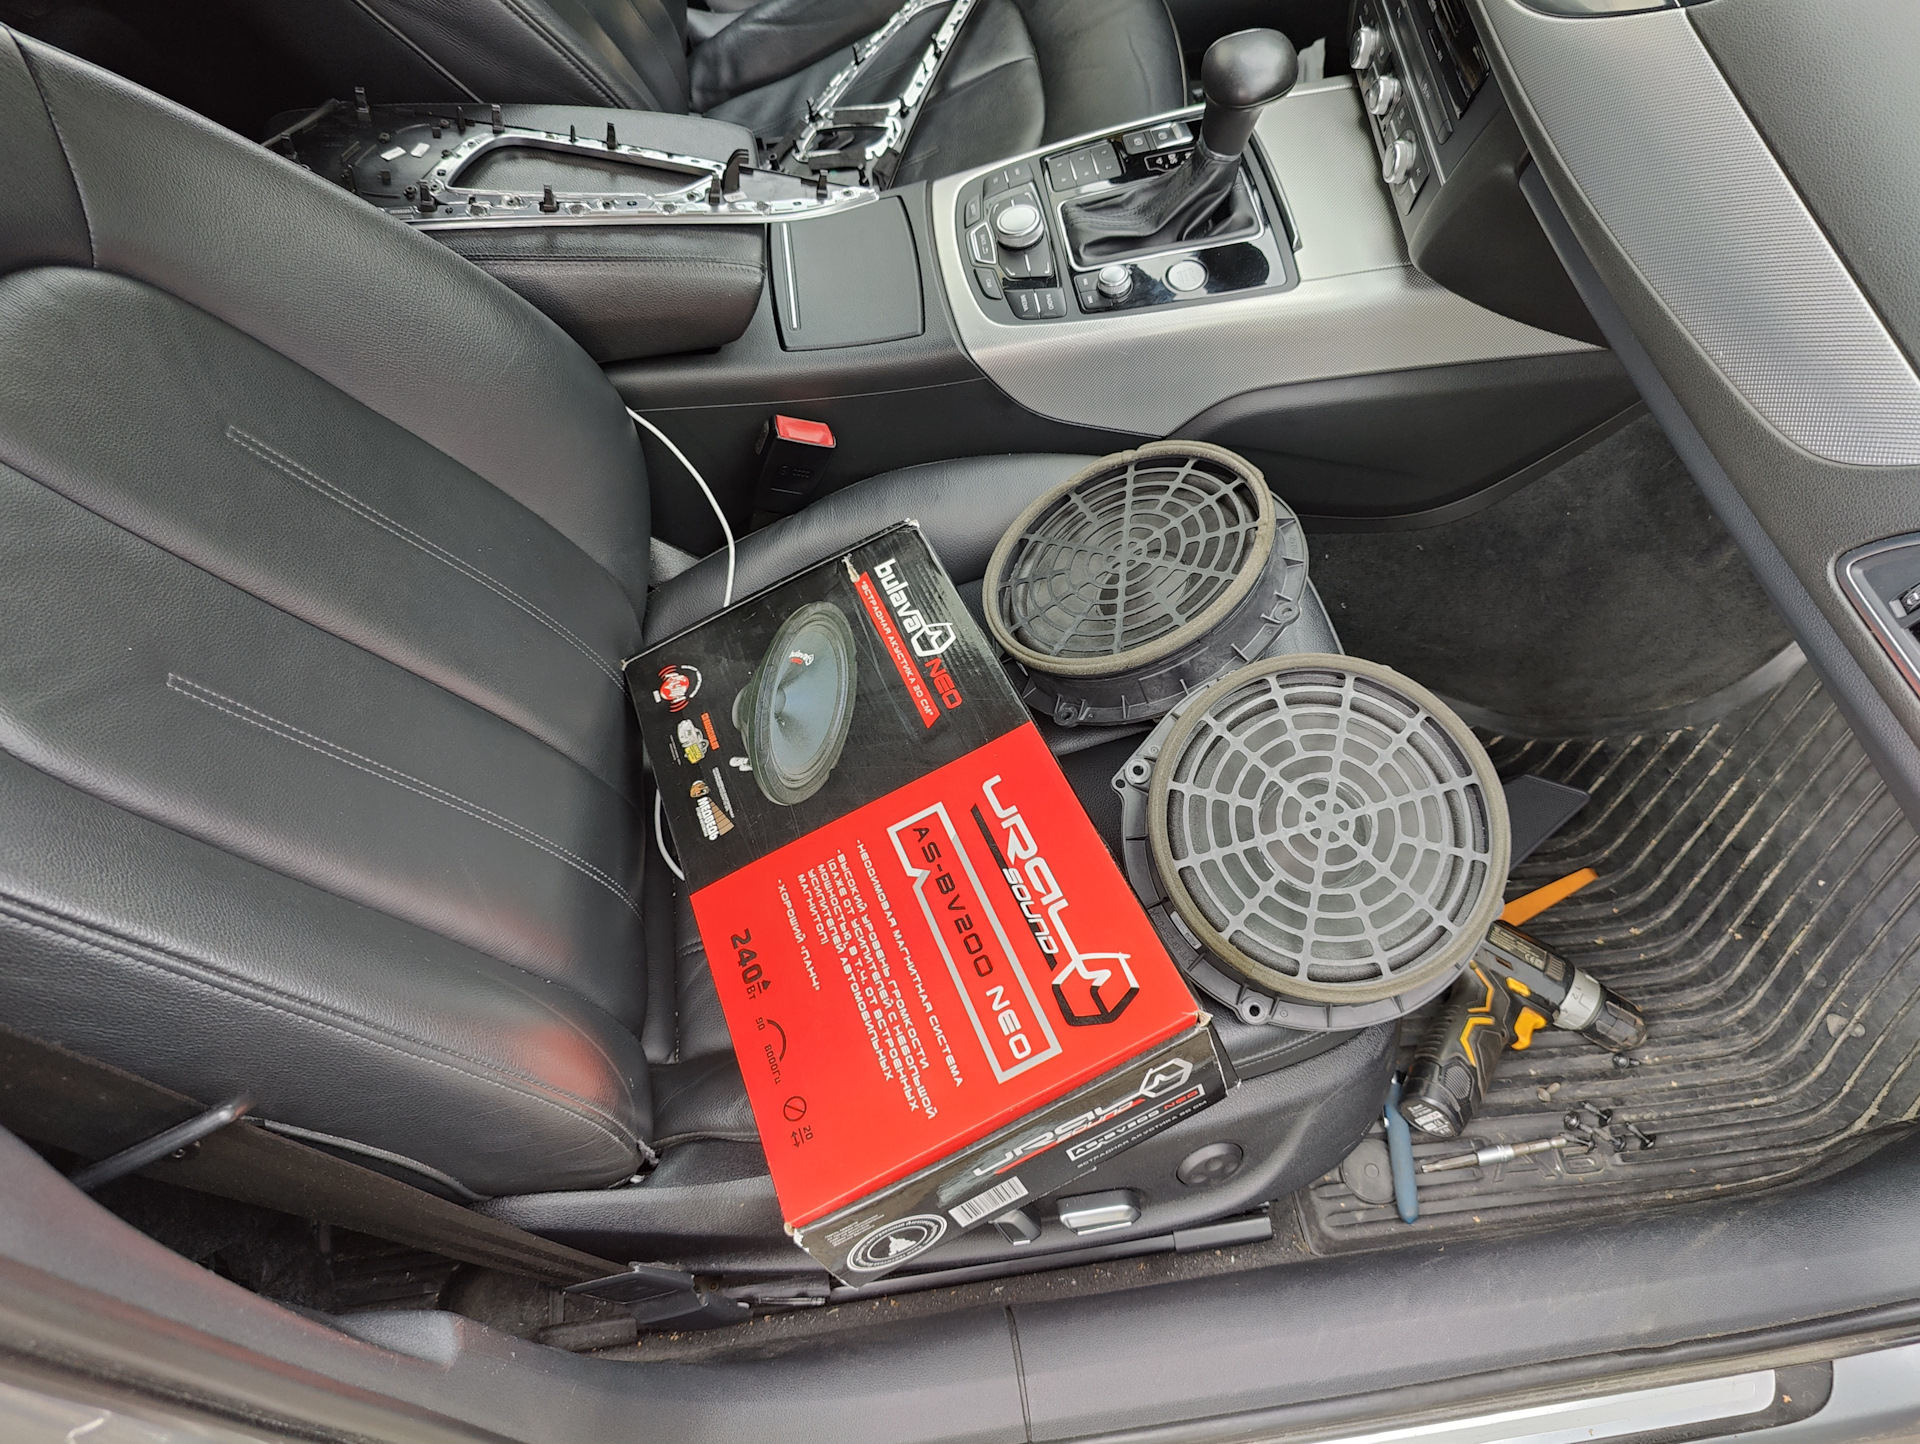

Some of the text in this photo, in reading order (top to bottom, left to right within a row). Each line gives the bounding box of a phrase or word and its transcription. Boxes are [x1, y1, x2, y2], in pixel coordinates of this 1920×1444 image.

[874, 558, 962, 709] bulava NEO
[888, 636, 916, 684] АКУСТИКА
[913, 685, 924, 698] 20
[698, 796, 720, 842] МЕДВЕДЬ
[983, 776, 1077, 955] URAL
[731, 928, 763, 1000] 240 Вт
[808, 869, 893, 1081] УСИЛИТЕЛЕЙ АВТОМОБИЛЬНЫХ
[913, 828, 1033, 1060] AS-BV200 NEO
[999, 860, 1059, 962] SOUND
[827, 859, 937, 1119] (ДАЖЕ ОТ УСИЛИТЕЛЕЙ С НЕБОЛЬШОЙ
[848, 945, 858, 956] В
[854, 958, 868, 985] Т.Ч.
[865, 987, 878, 1005] ОТ
[873, 1009, 919, 1111] ВСТРОЕННЫХ
[861, 914, 890, 978] УРОВЕНЬ
[888, 980, 929, 1069] ГРОМКОСТИ
[893, 930, 933, 1013] МАГНИТНАЯ
[929, 1015, 963, 1087] СИСТЕМА
[803, 1125, 813, 1141] 20
[974, 1092, 1141, 1176] URAL
[1165, 1090, 1199, 1110] NEO
